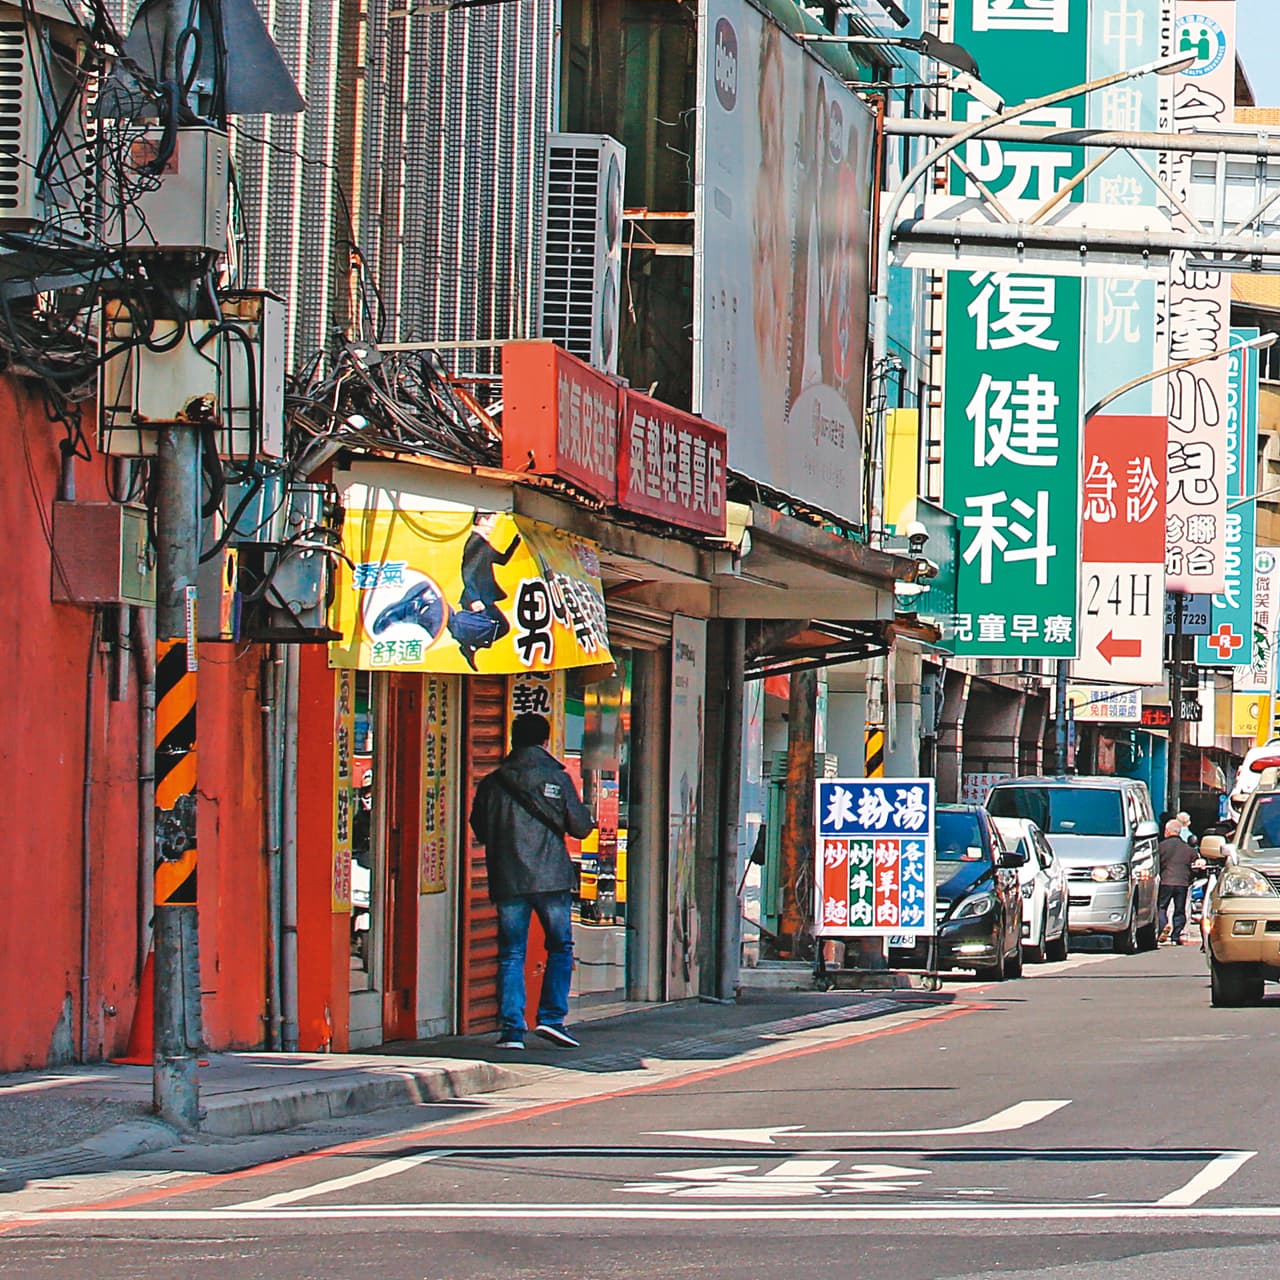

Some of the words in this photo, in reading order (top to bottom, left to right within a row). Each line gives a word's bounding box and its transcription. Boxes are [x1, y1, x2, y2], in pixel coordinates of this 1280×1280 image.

[1157, 98, 1168, 183] HSNG
[1084, 453, 1160, 527] 急診
[353, 562, 403, 588] 透氣
[1086, 574, 1151, 618] 24H
[372, 639, 423, 665] 舒適
[823, 785, 927, 831] 米粉湯
[824, 841, 848, 924] 炒麵
[850, 841, 874, 924] 炒牛肉
[875, 841, 900, 924] 炒羊肉
[901, 841, 925, 924] 各式小炒
